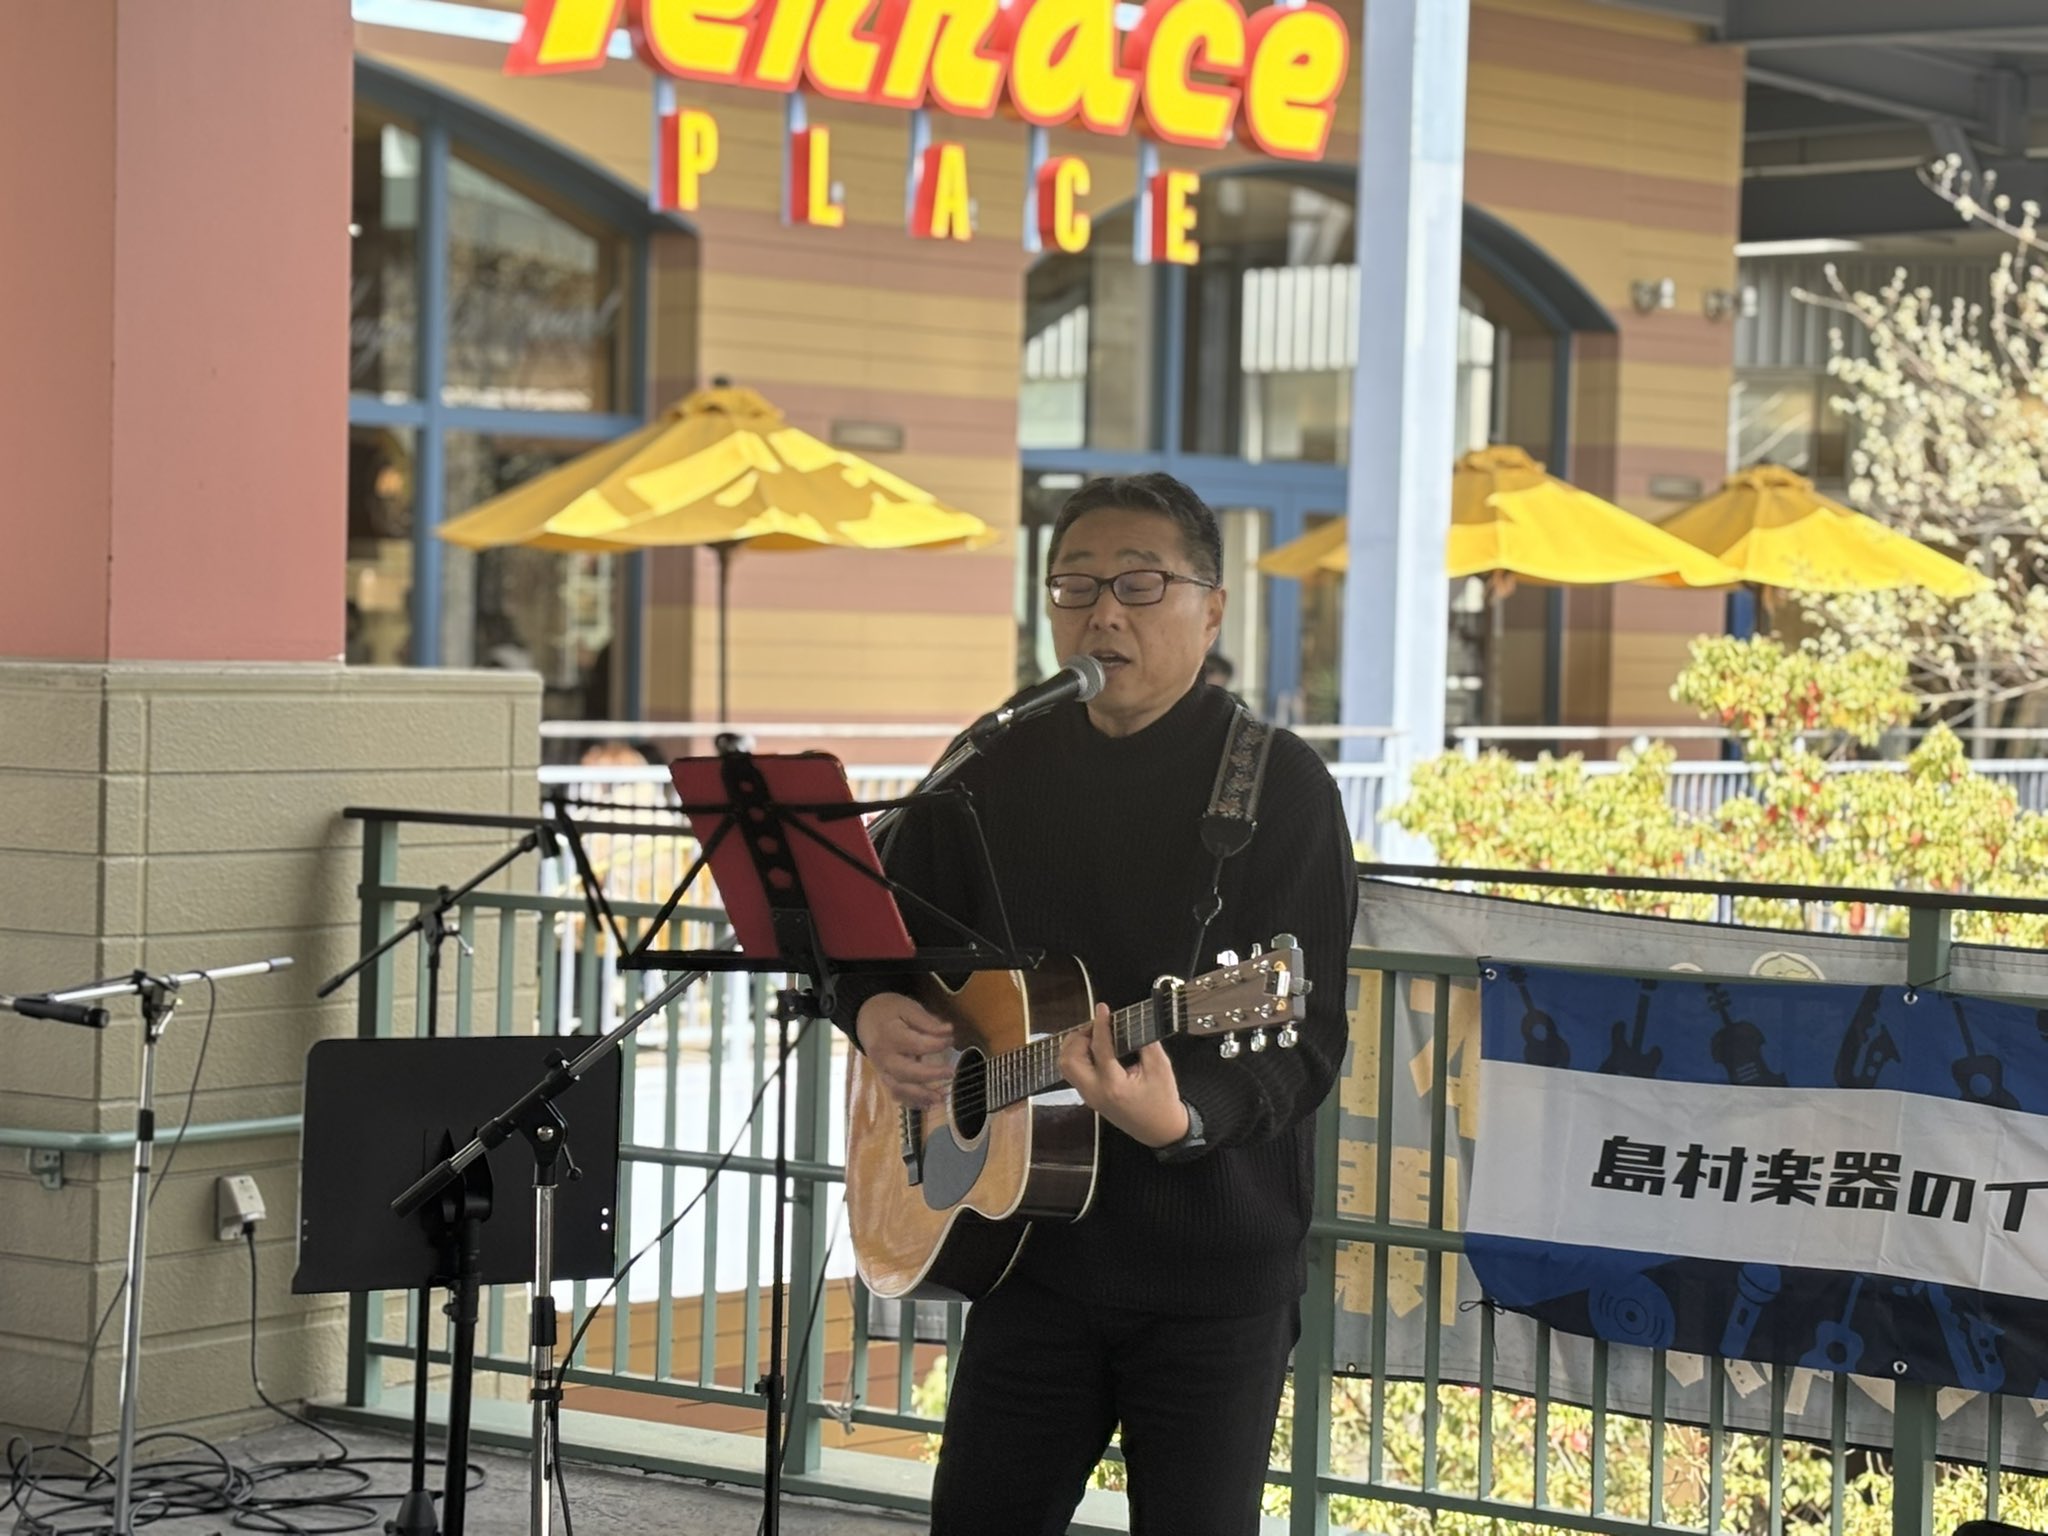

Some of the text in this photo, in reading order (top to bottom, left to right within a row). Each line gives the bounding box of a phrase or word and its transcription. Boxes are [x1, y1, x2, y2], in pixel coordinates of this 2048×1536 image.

[670, 107, 1200, 266] PLACE
[1591, 1135, 2048, 1232] 島村楽器のイ
